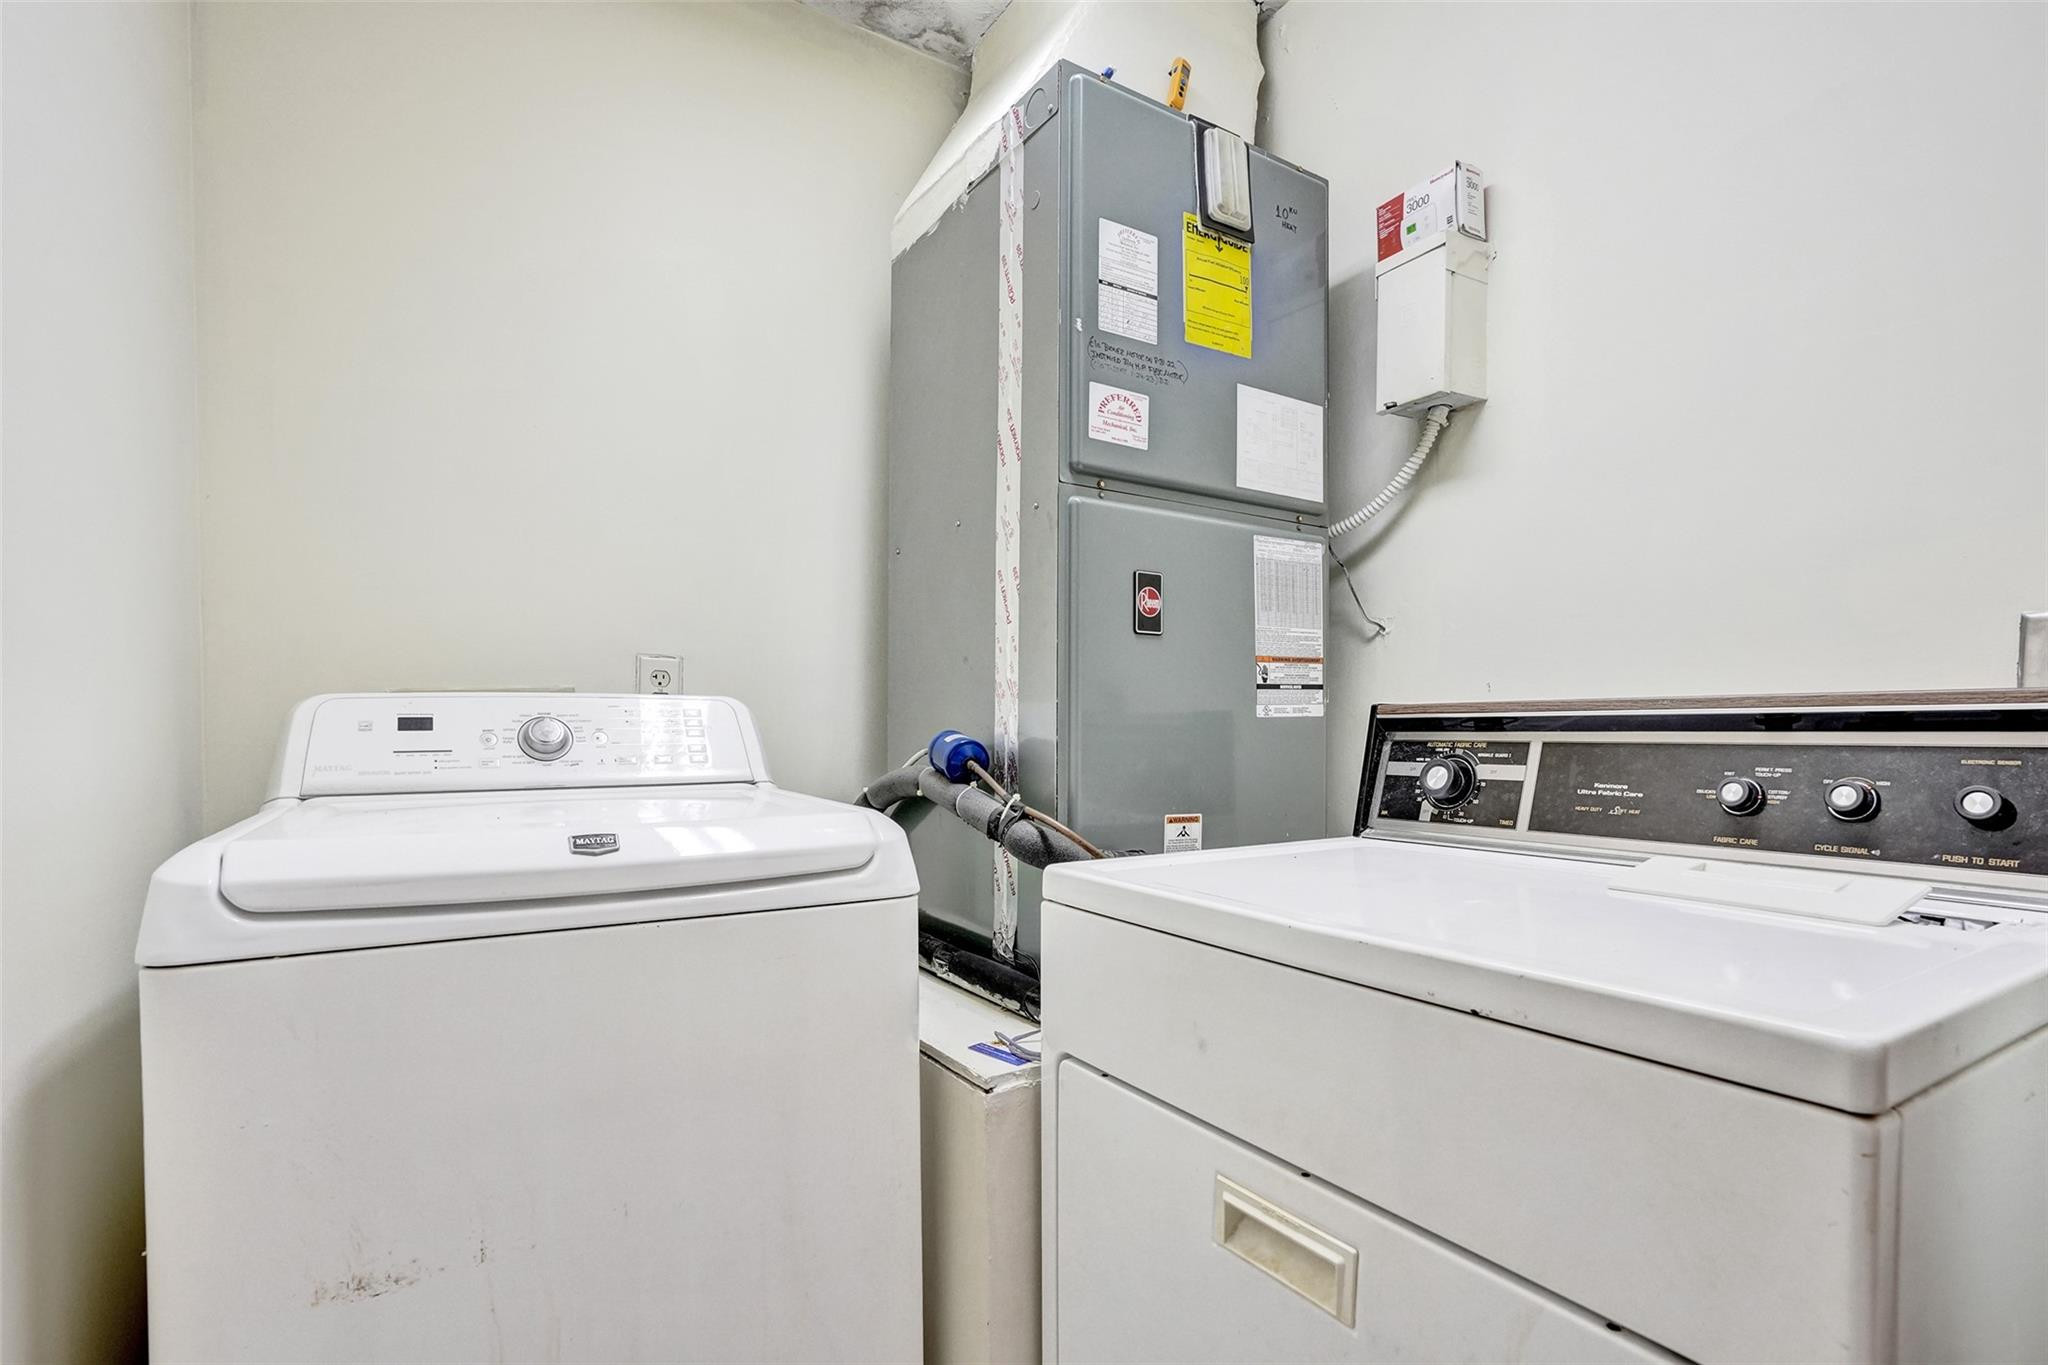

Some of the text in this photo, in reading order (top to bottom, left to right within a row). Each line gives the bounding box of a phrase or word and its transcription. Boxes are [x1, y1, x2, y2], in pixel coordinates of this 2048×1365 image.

[1406, 194, 1430, 214] 3000
[1275, 204, 1289, 220] 10
[1097, 393, 1142, 423] PREFERRED
[1106, 409, 1135, 421] Conditioning
[1594, 782, 1628, 790] Kenmore
[1598, 789, 1622, 797] Fabric
[1623, 790, 1644, 798] Care
[1173, 815, 1200, 824] WARNING
[575, 837, 615, 845] MAYTAG
[1713, 836, 1758, 846] FABRIC CARE
[1814, 844, 1870, 855] CYCLE SIGNAL
[1942, 855, 2021, 868] PUSH TO START
[1008, 880, 1017, 897] 339
